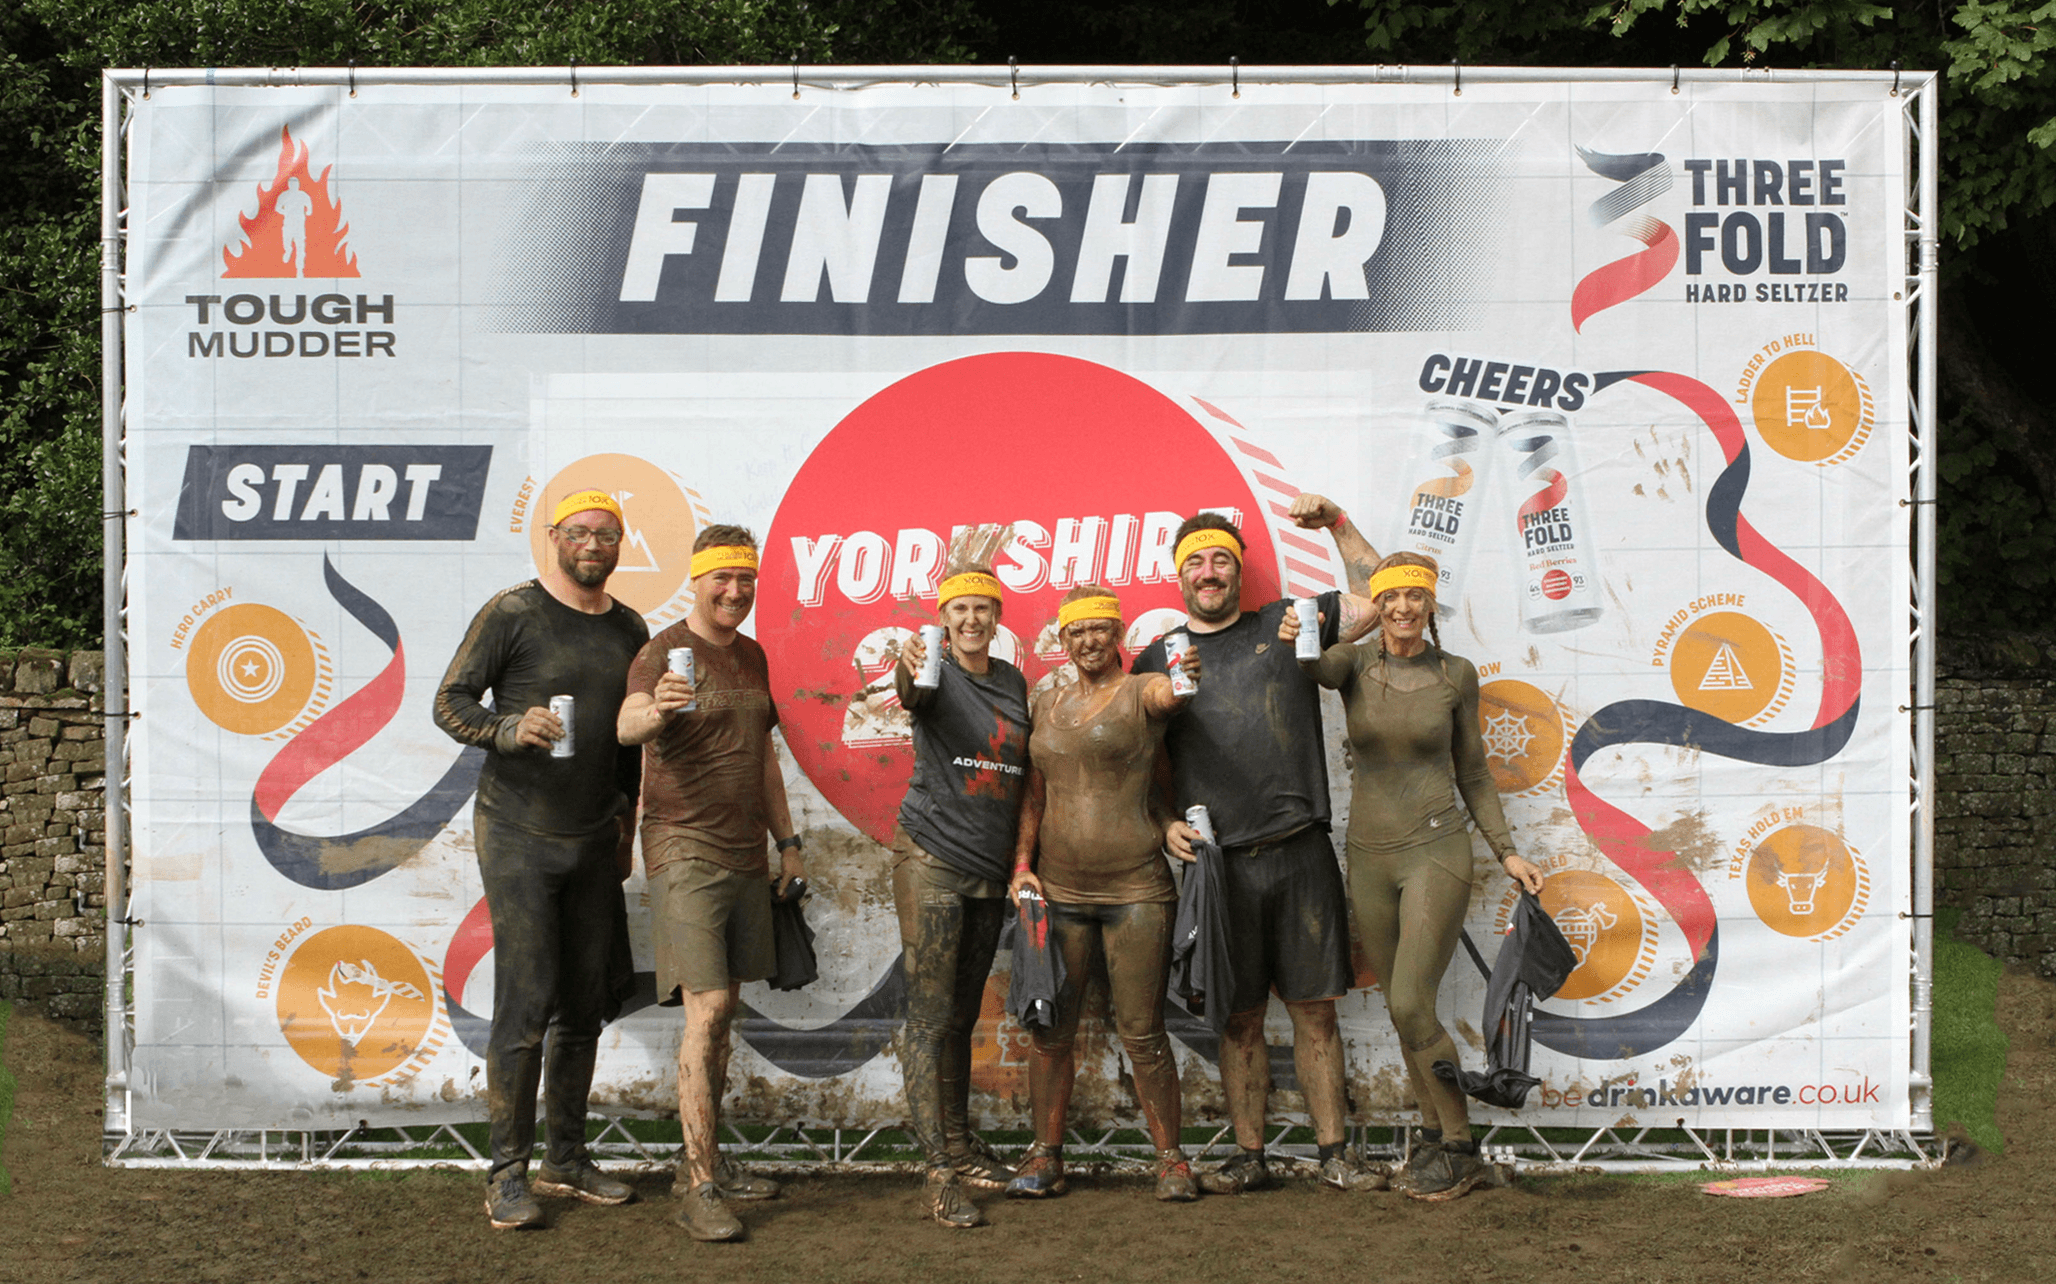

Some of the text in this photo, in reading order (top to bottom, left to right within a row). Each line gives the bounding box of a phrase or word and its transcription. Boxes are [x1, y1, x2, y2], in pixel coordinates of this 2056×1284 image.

[1684, 159, 1846, 206] THREE
[619, 171, 1387, 305] FINISHER
[1685, 211, 1847, 275] FOLD
[185, 293, 394, 325] TOUGH
[1686, 283, 1848, 303] HARD SELTZER
[188, 331, 396, 358] MUDDER
[1419, 354, 1589, 412] CHEERS
[1735, 333, 1815, 404] LADDER TO HELL
[221, 463, 442, 522] START
[510, 475, 537, 533] EVEREST
[1417, 493, 1464, 517] THREE
[1410, 508, 1459, 535] FOLD
[1522, 507, 1570, 528] THREE
[1408, 528, 1455, 544] HARD SELTZER
[1524, 523, 1572, 549] FOLD
[1527, 543, 1575, 557] HARD SELTZER
[1441, 569, 1451, 580] 93
[1529, 556, 1577, 571] Red Berries
[1573, 576, 1584, 584] 93
[170, 586, 232, 650] HERO CARRY
[1652, 593, 1745, 666] PYRAMID SCHEME
[1728, 806, 1803, 880] TEXAS HOLD EM
[256, 916, 312, 999] DEVIL'S BEARD
